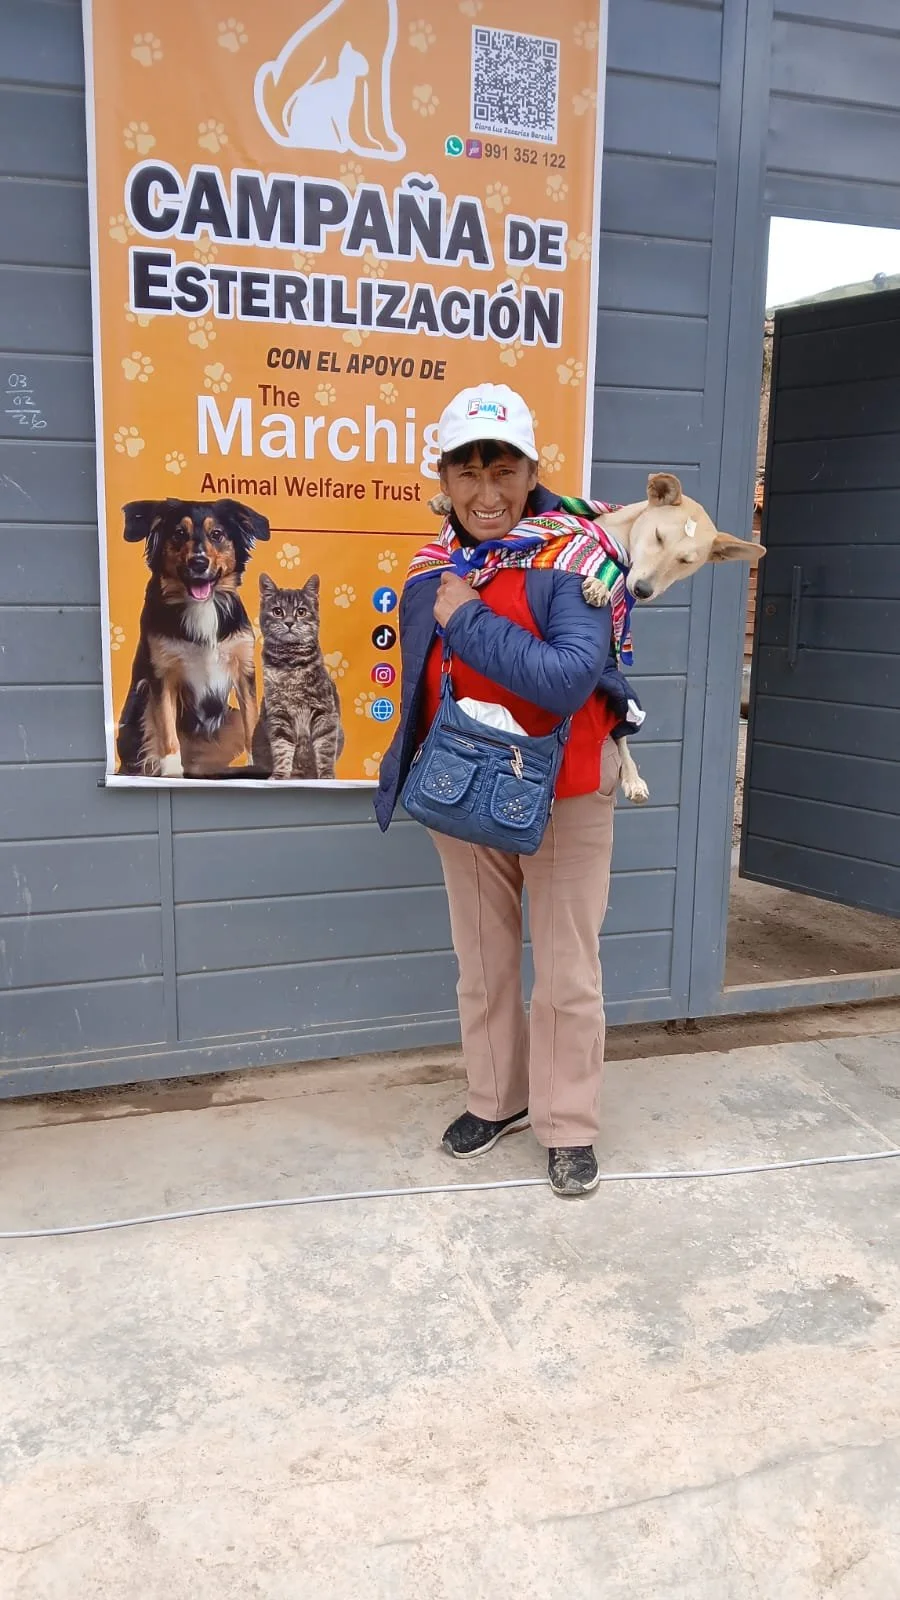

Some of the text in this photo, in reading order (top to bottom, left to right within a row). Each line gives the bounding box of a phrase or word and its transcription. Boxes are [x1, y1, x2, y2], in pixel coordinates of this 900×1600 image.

[484, 143, 508, 160] 991
[514, 147, 538, 165] 352
[543, 152, 566, 168] 122
[128, 164, 564, 266] CAMPAÑA DE
[132, 250, 561, 345] ESTERILIZACIÓN
[266, 347, 447, 380] CON EL APOYO DE
[8, 373, 27, 388] 03
[258, 384, 300, 408] The
[201, 472, 421, 502] Animal Welfare Trust
